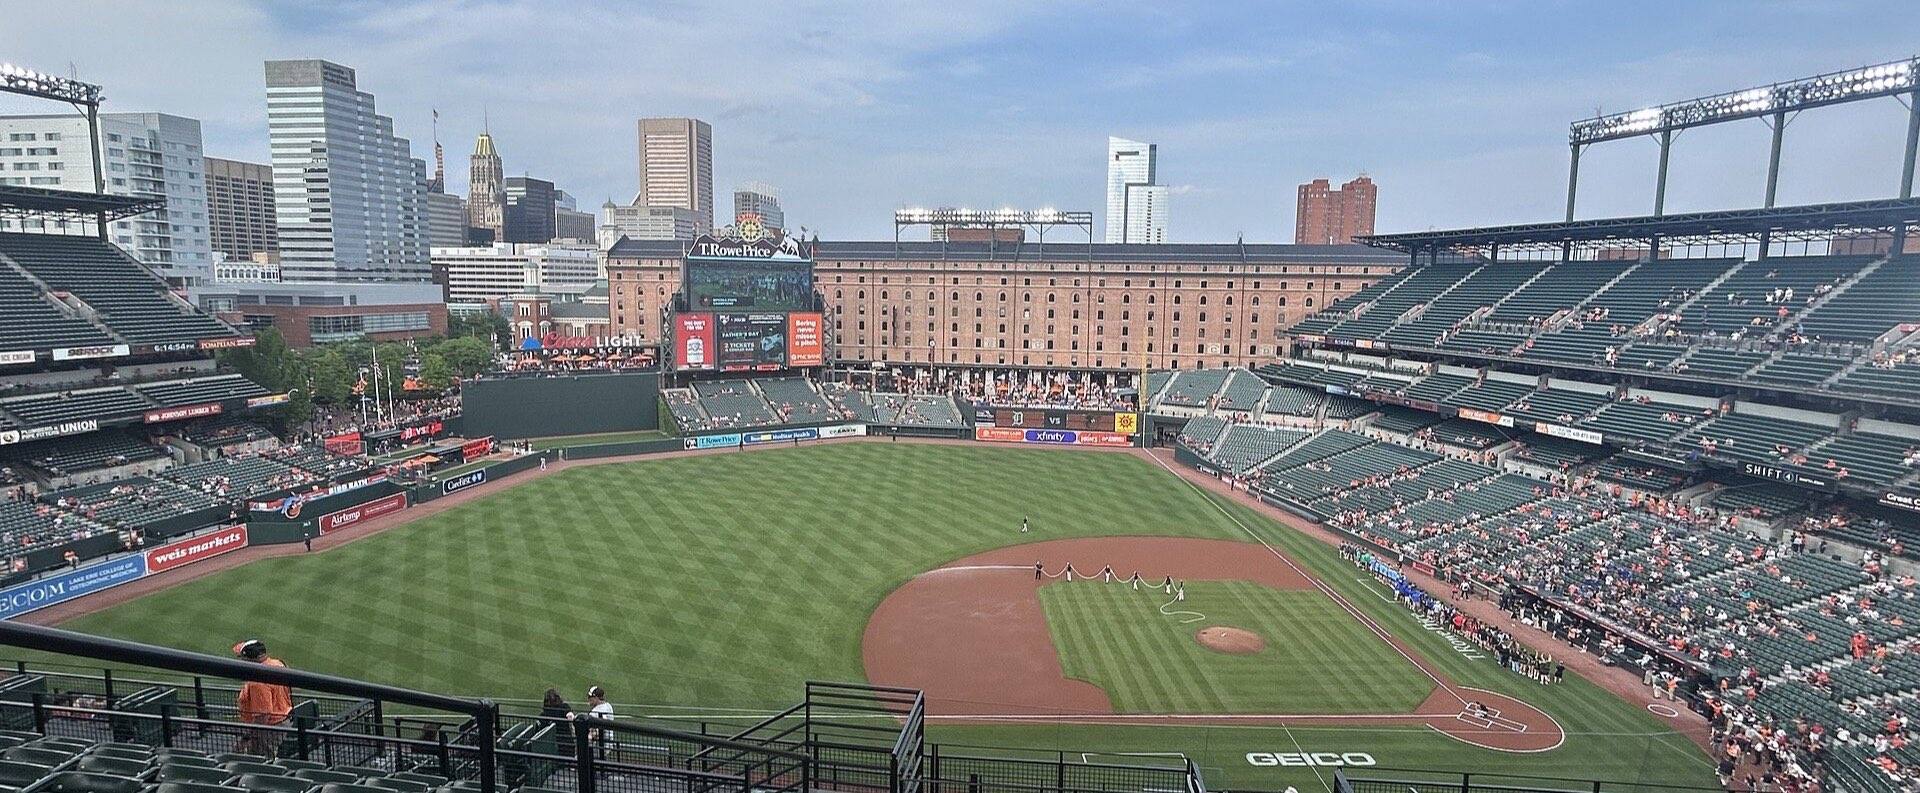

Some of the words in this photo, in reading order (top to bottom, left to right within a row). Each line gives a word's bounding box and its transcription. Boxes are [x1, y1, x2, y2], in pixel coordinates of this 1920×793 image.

[596, 335, 642, 347] LIGHT
[60, 419, 98, 433] UNION
[1036, 431, 1065, 442] xfinity
[1745, 463, 1782, 479] SHIFT
[331, 511, 361, 526] Airtemp
[155, 548, 187, 564] weis
[188, 533, 241, 554] markets
[69, 577, 85, 585] LAKE
[86, 572, 98, 581] ERIE
[99, 565, 125, 577] COLLEGE
[111, 568, 137, 579] MEDICINE
[1246, 752, 1377, 766] GEICO
